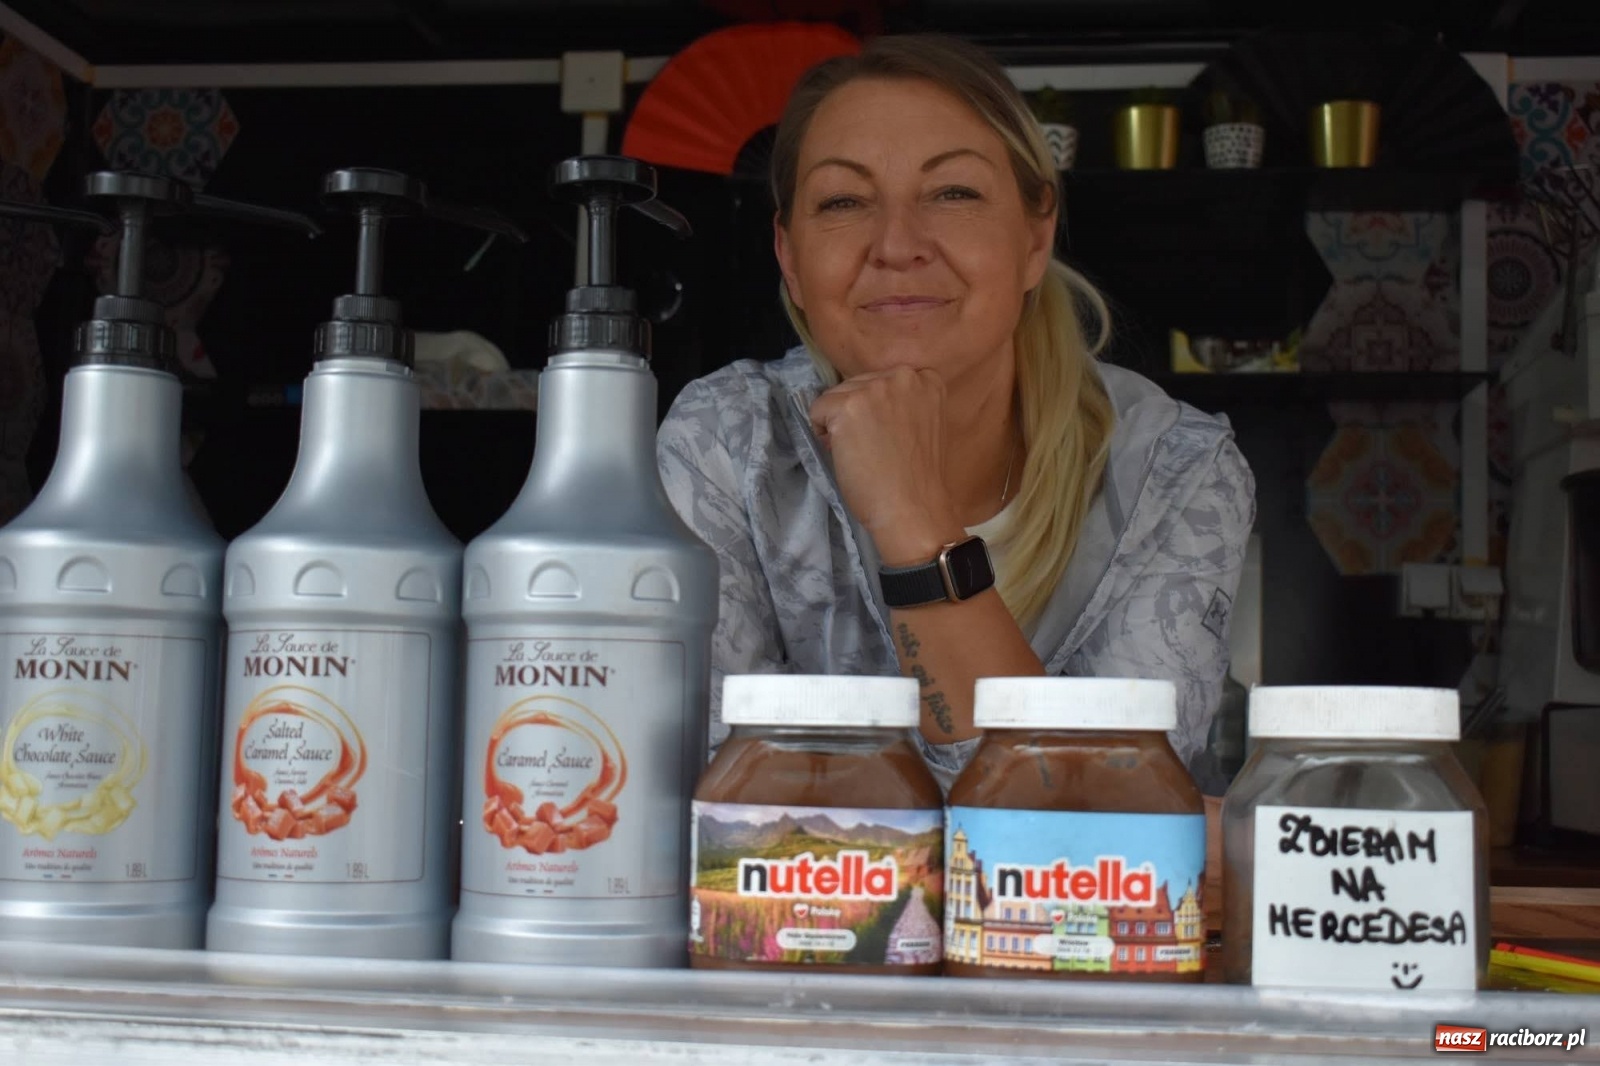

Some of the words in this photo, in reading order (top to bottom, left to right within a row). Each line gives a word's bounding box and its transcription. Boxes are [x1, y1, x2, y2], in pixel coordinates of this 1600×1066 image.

[50, 636, 99, 656] Sauce
[103, 644, 122, 656] de
[272, 633, 317, 653] Sauce
[321, 640, 338, 653] de
[528, 641, 576, 662] Sauce
[579, 650, 598, 662] de
[14, 658, 132, 681] MONIN
[244, 656, 349, 677] MONIN
[494, 665, 608, 687] MONIN
[38, 724, 84, 742] White
[263, 719, 304, 743] Salted
[13, 742, 72, 765] Chocolate
[71, 743, 116, 768] Sauce
[245, 740, 289, 760] Caramel
[290, 740, 332, 765] Sauce
[497, 747, 547, 768] Caramel
[548, 747, 593, 773] Sauce
[743, 855, 893, 896] nutella
[998, 859, 1151, 901] nutella
[1332, 866, 1385, 902] NA
